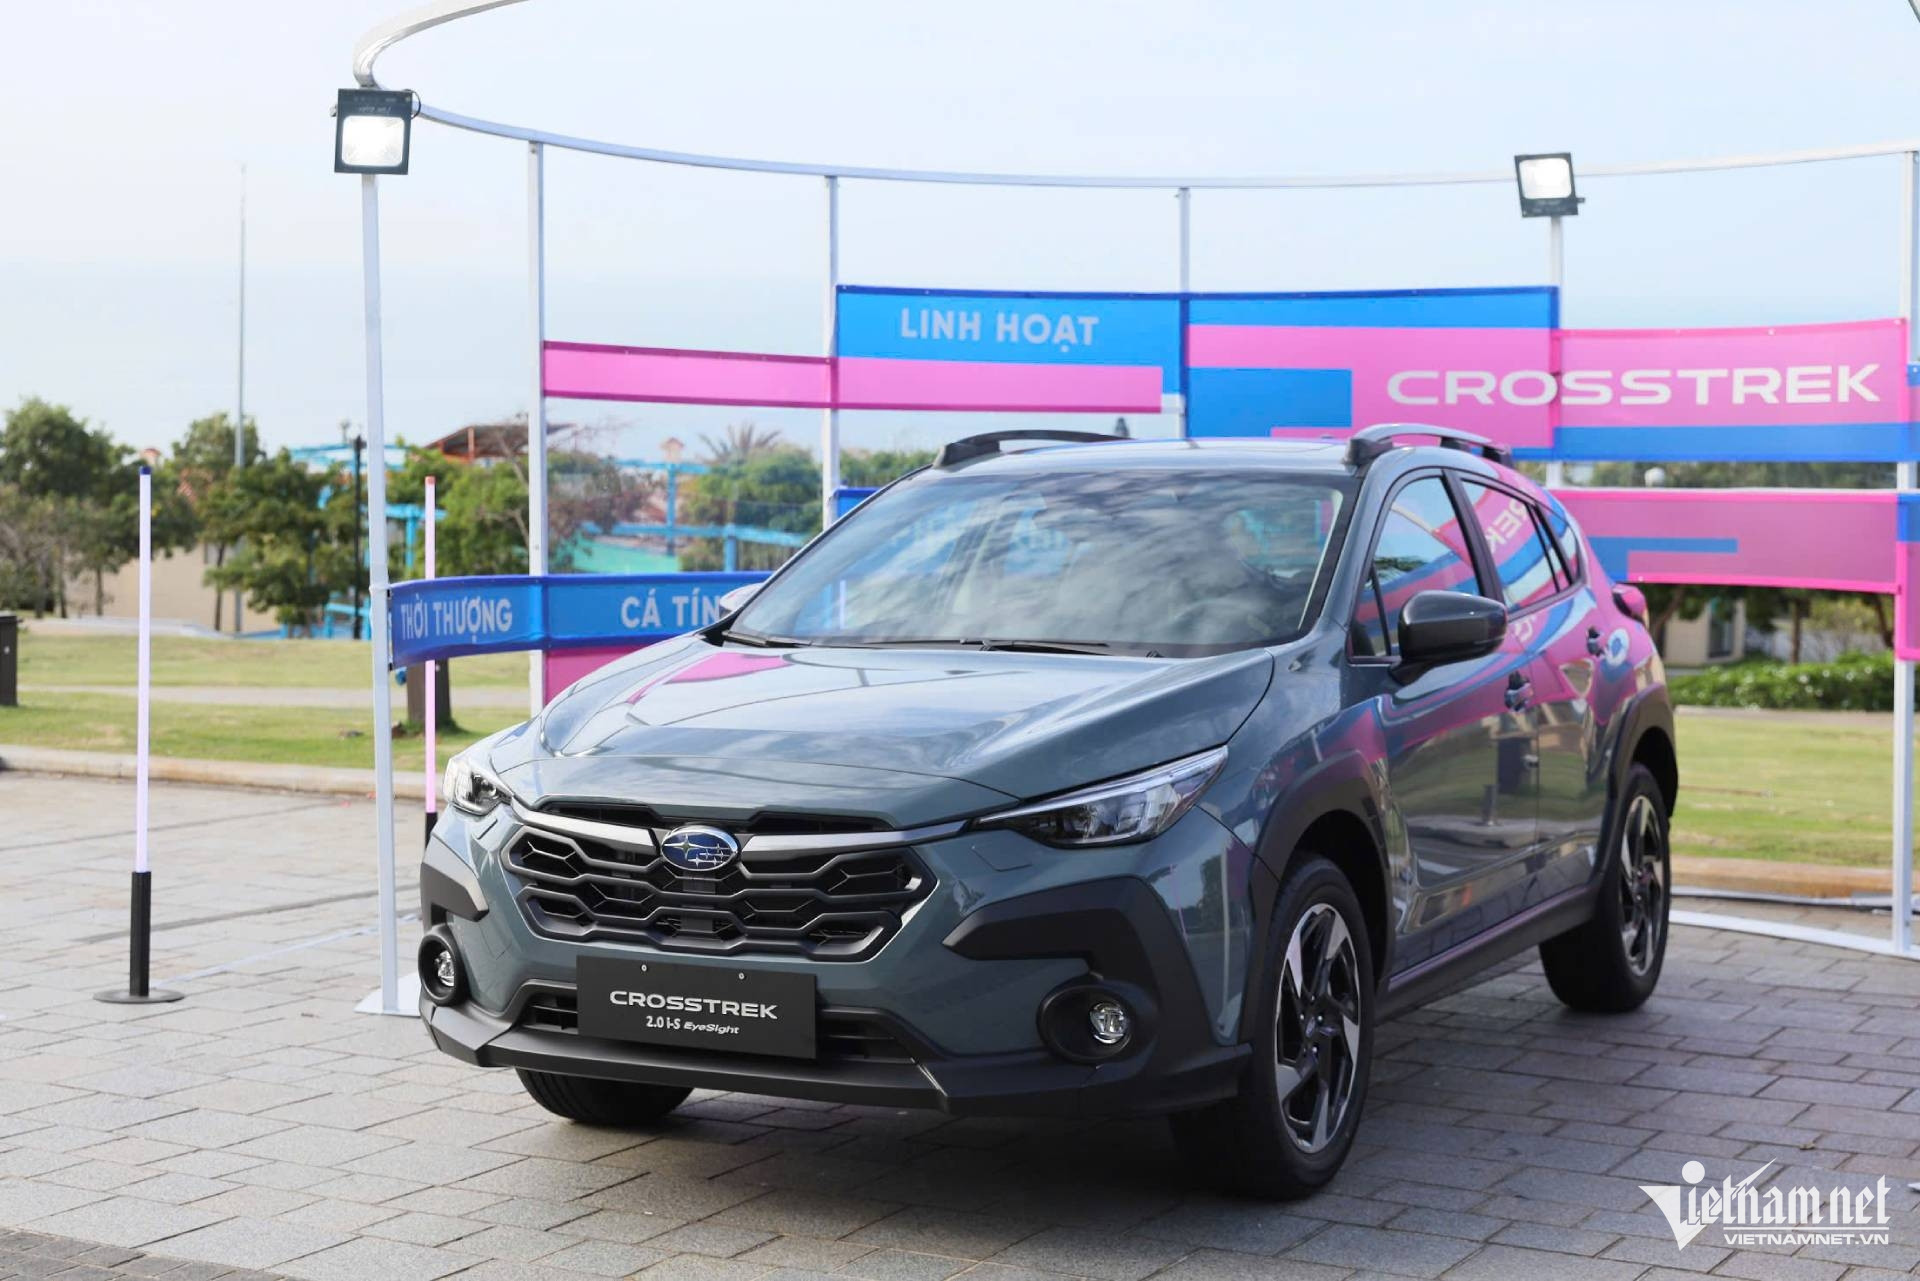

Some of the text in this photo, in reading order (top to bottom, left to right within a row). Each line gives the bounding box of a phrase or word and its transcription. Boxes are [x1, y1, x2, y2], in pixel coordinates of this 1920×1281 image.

[901, 308, 1099, 352] LINH HOẠT
[1387, 364, 1880, 407] CROSSTREK
[400, 593, 513, 644] THỜI THƯỢNG
[620, 587, 661, 629] CÁ
[609, 990, 778, 1020] CROSSTREK
[645, 1015, 664, 1029] 2.0
[683, 1021, 740, 1035] EyeSight
